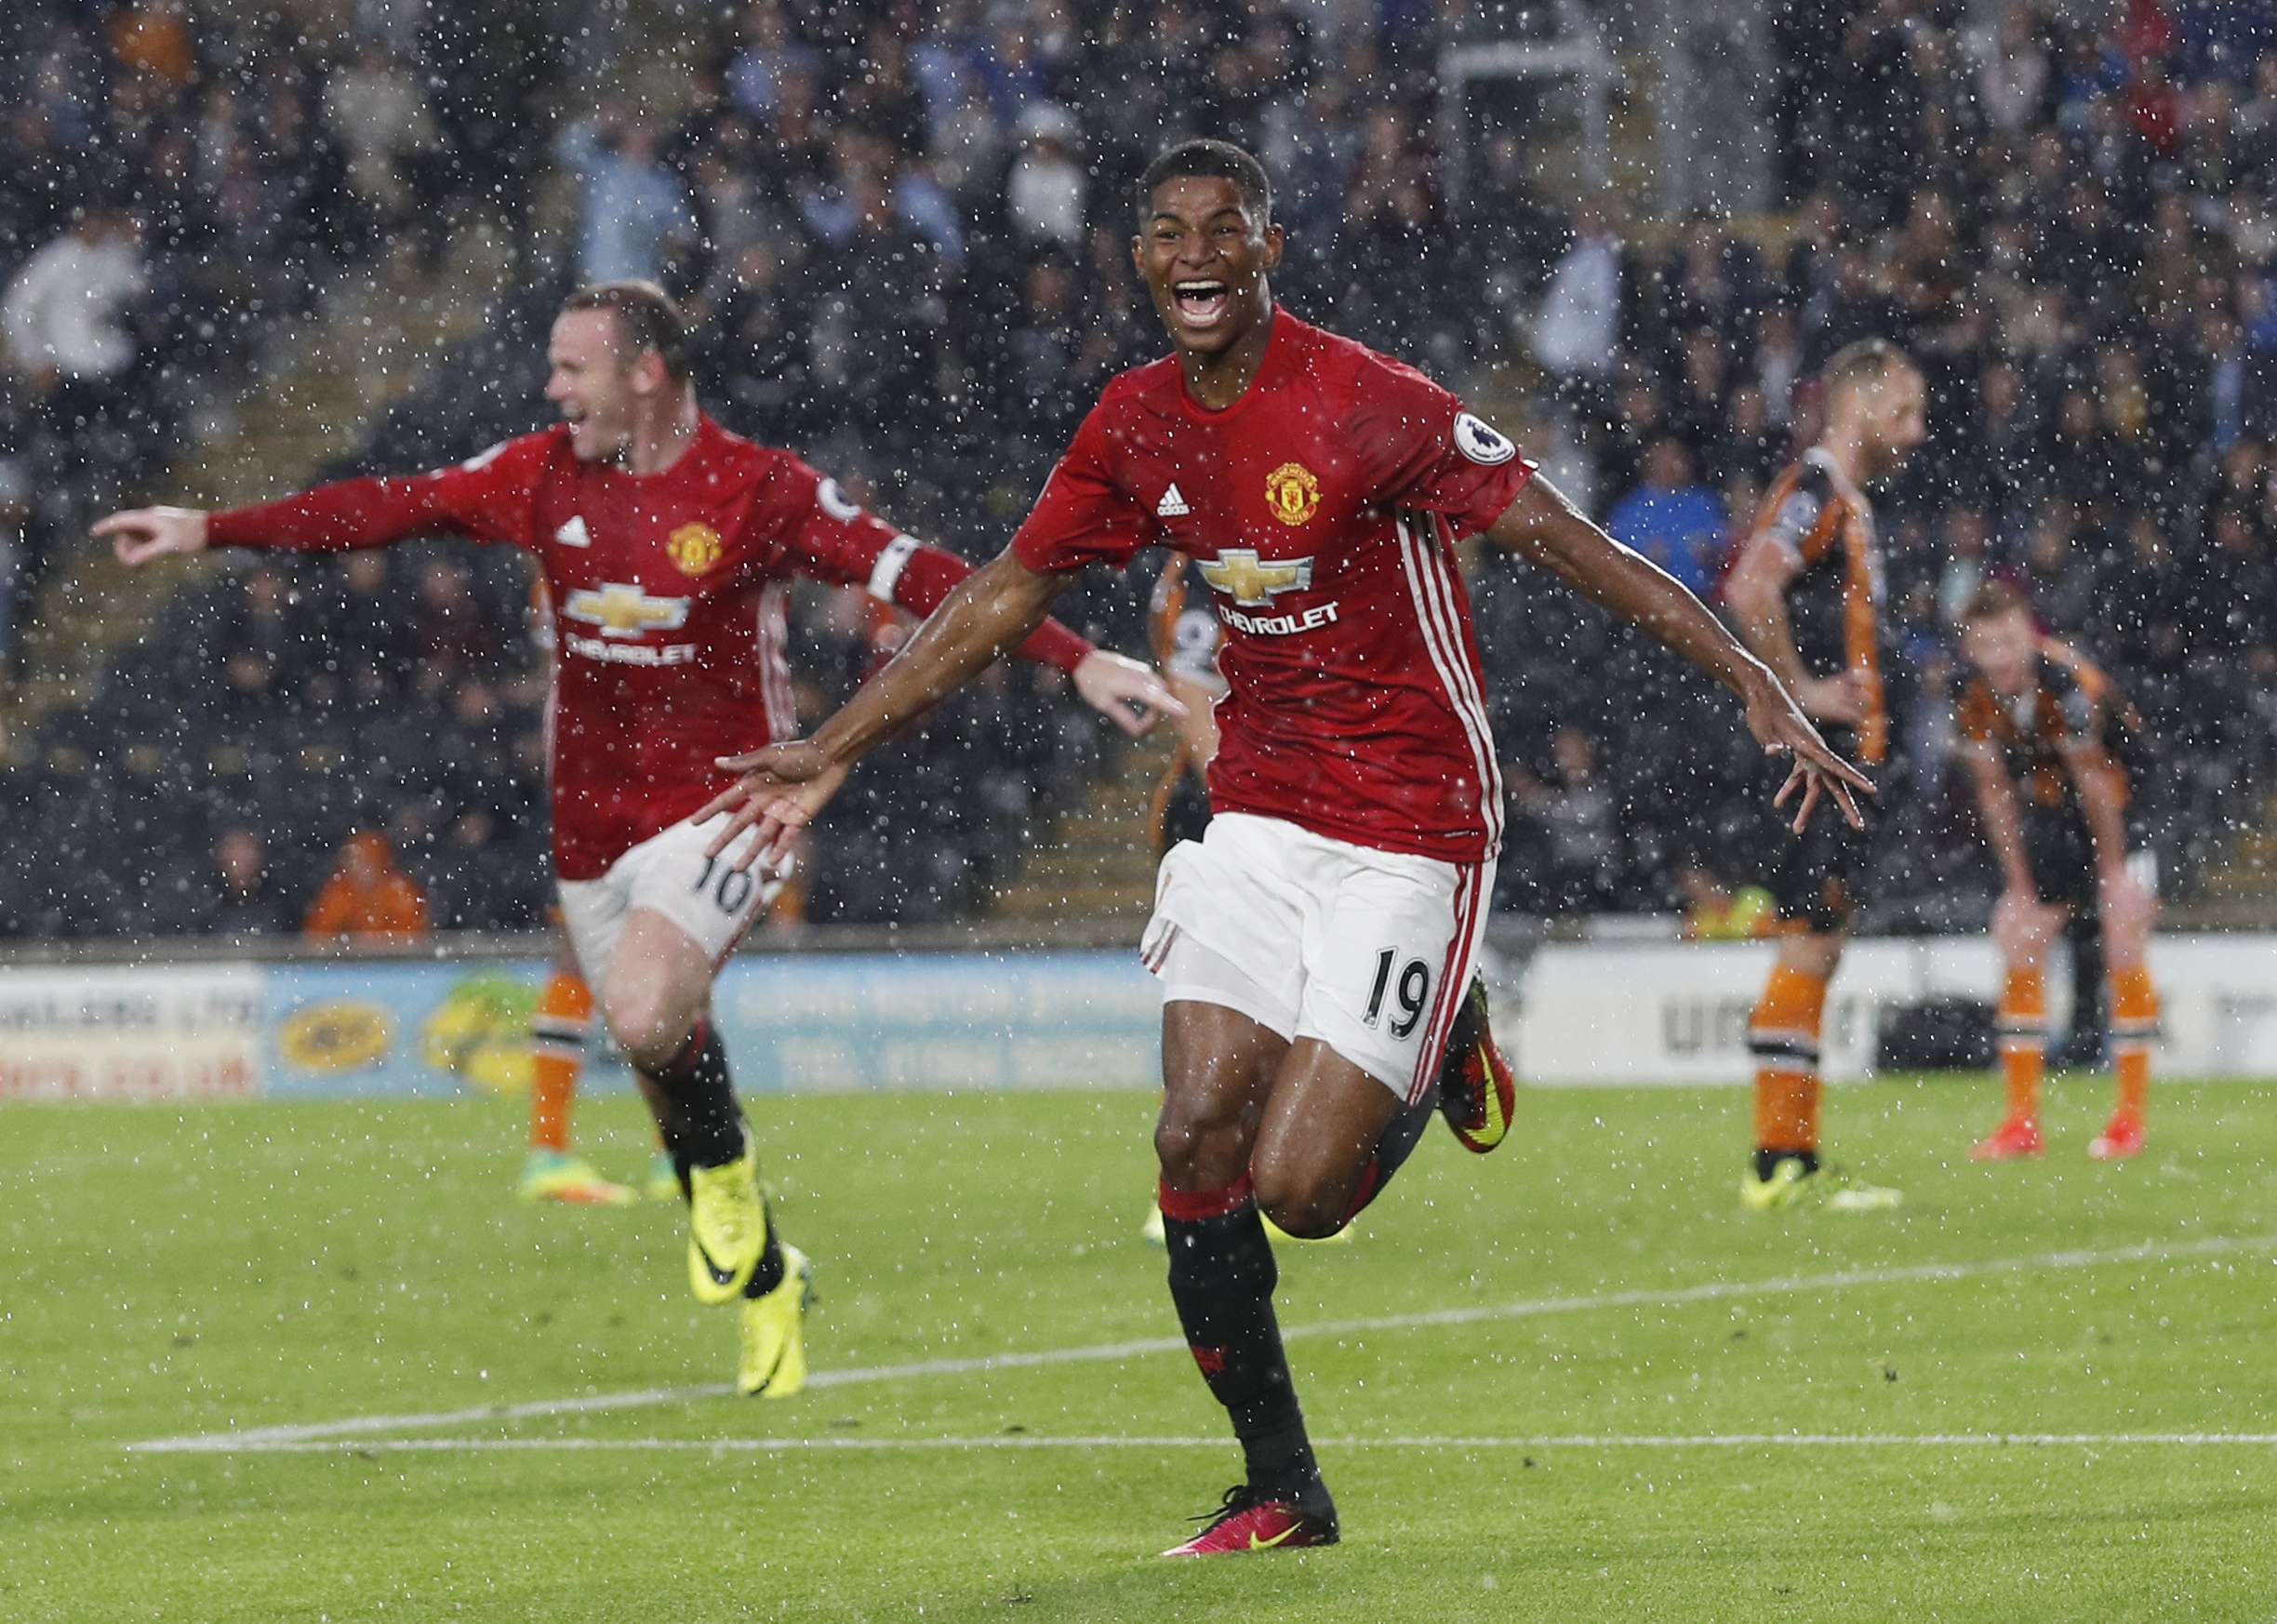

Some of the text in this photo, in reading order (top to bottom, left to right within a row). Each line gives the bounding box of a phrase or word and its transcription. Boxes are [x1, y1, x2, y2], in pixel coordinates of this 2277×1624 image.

[1157, 503, 1190, 516] adidas
[1277, 510, 1310, 522] UNITED
[1218, 600, 1339, 635] CHEVROLET
[692, 854, 752, 914] 10
[1361, 945, 1431, 1042] 19
